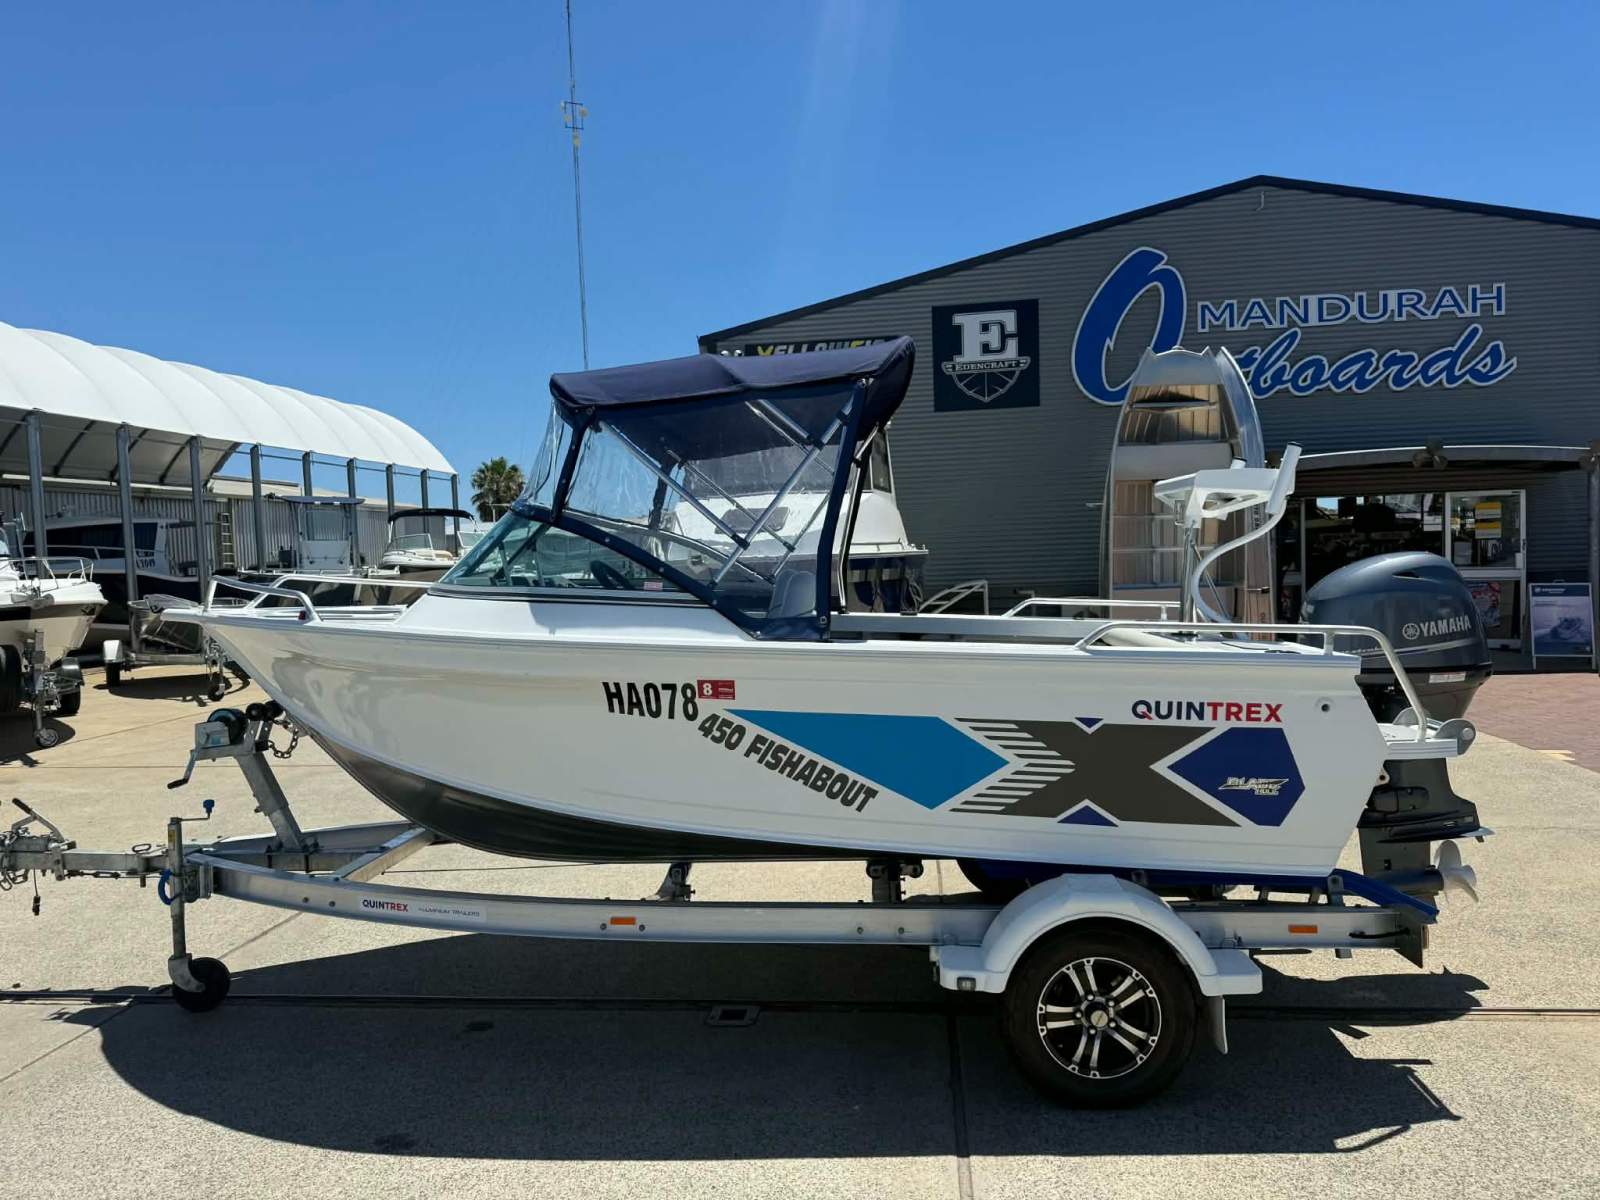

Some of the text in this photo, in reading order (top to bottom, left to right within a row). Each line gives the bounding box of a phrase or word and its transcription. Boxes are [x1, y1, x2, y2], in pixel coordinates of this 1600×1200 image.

[1196, 281, 1506, 333] MANDURAH
[955, 360, 1018, 371] EDENCRAFT
[1420, 615, 1472, 637] YAMAHA
[703, 683, 712, 695] 8
[602, 681, 698, 722] HA078
[1131, 699, 1283, 723] QUINTREX
[698, 713, 879, 813] 450 FISHABOUT
[362, 899, 408, 912] QUINTREX
